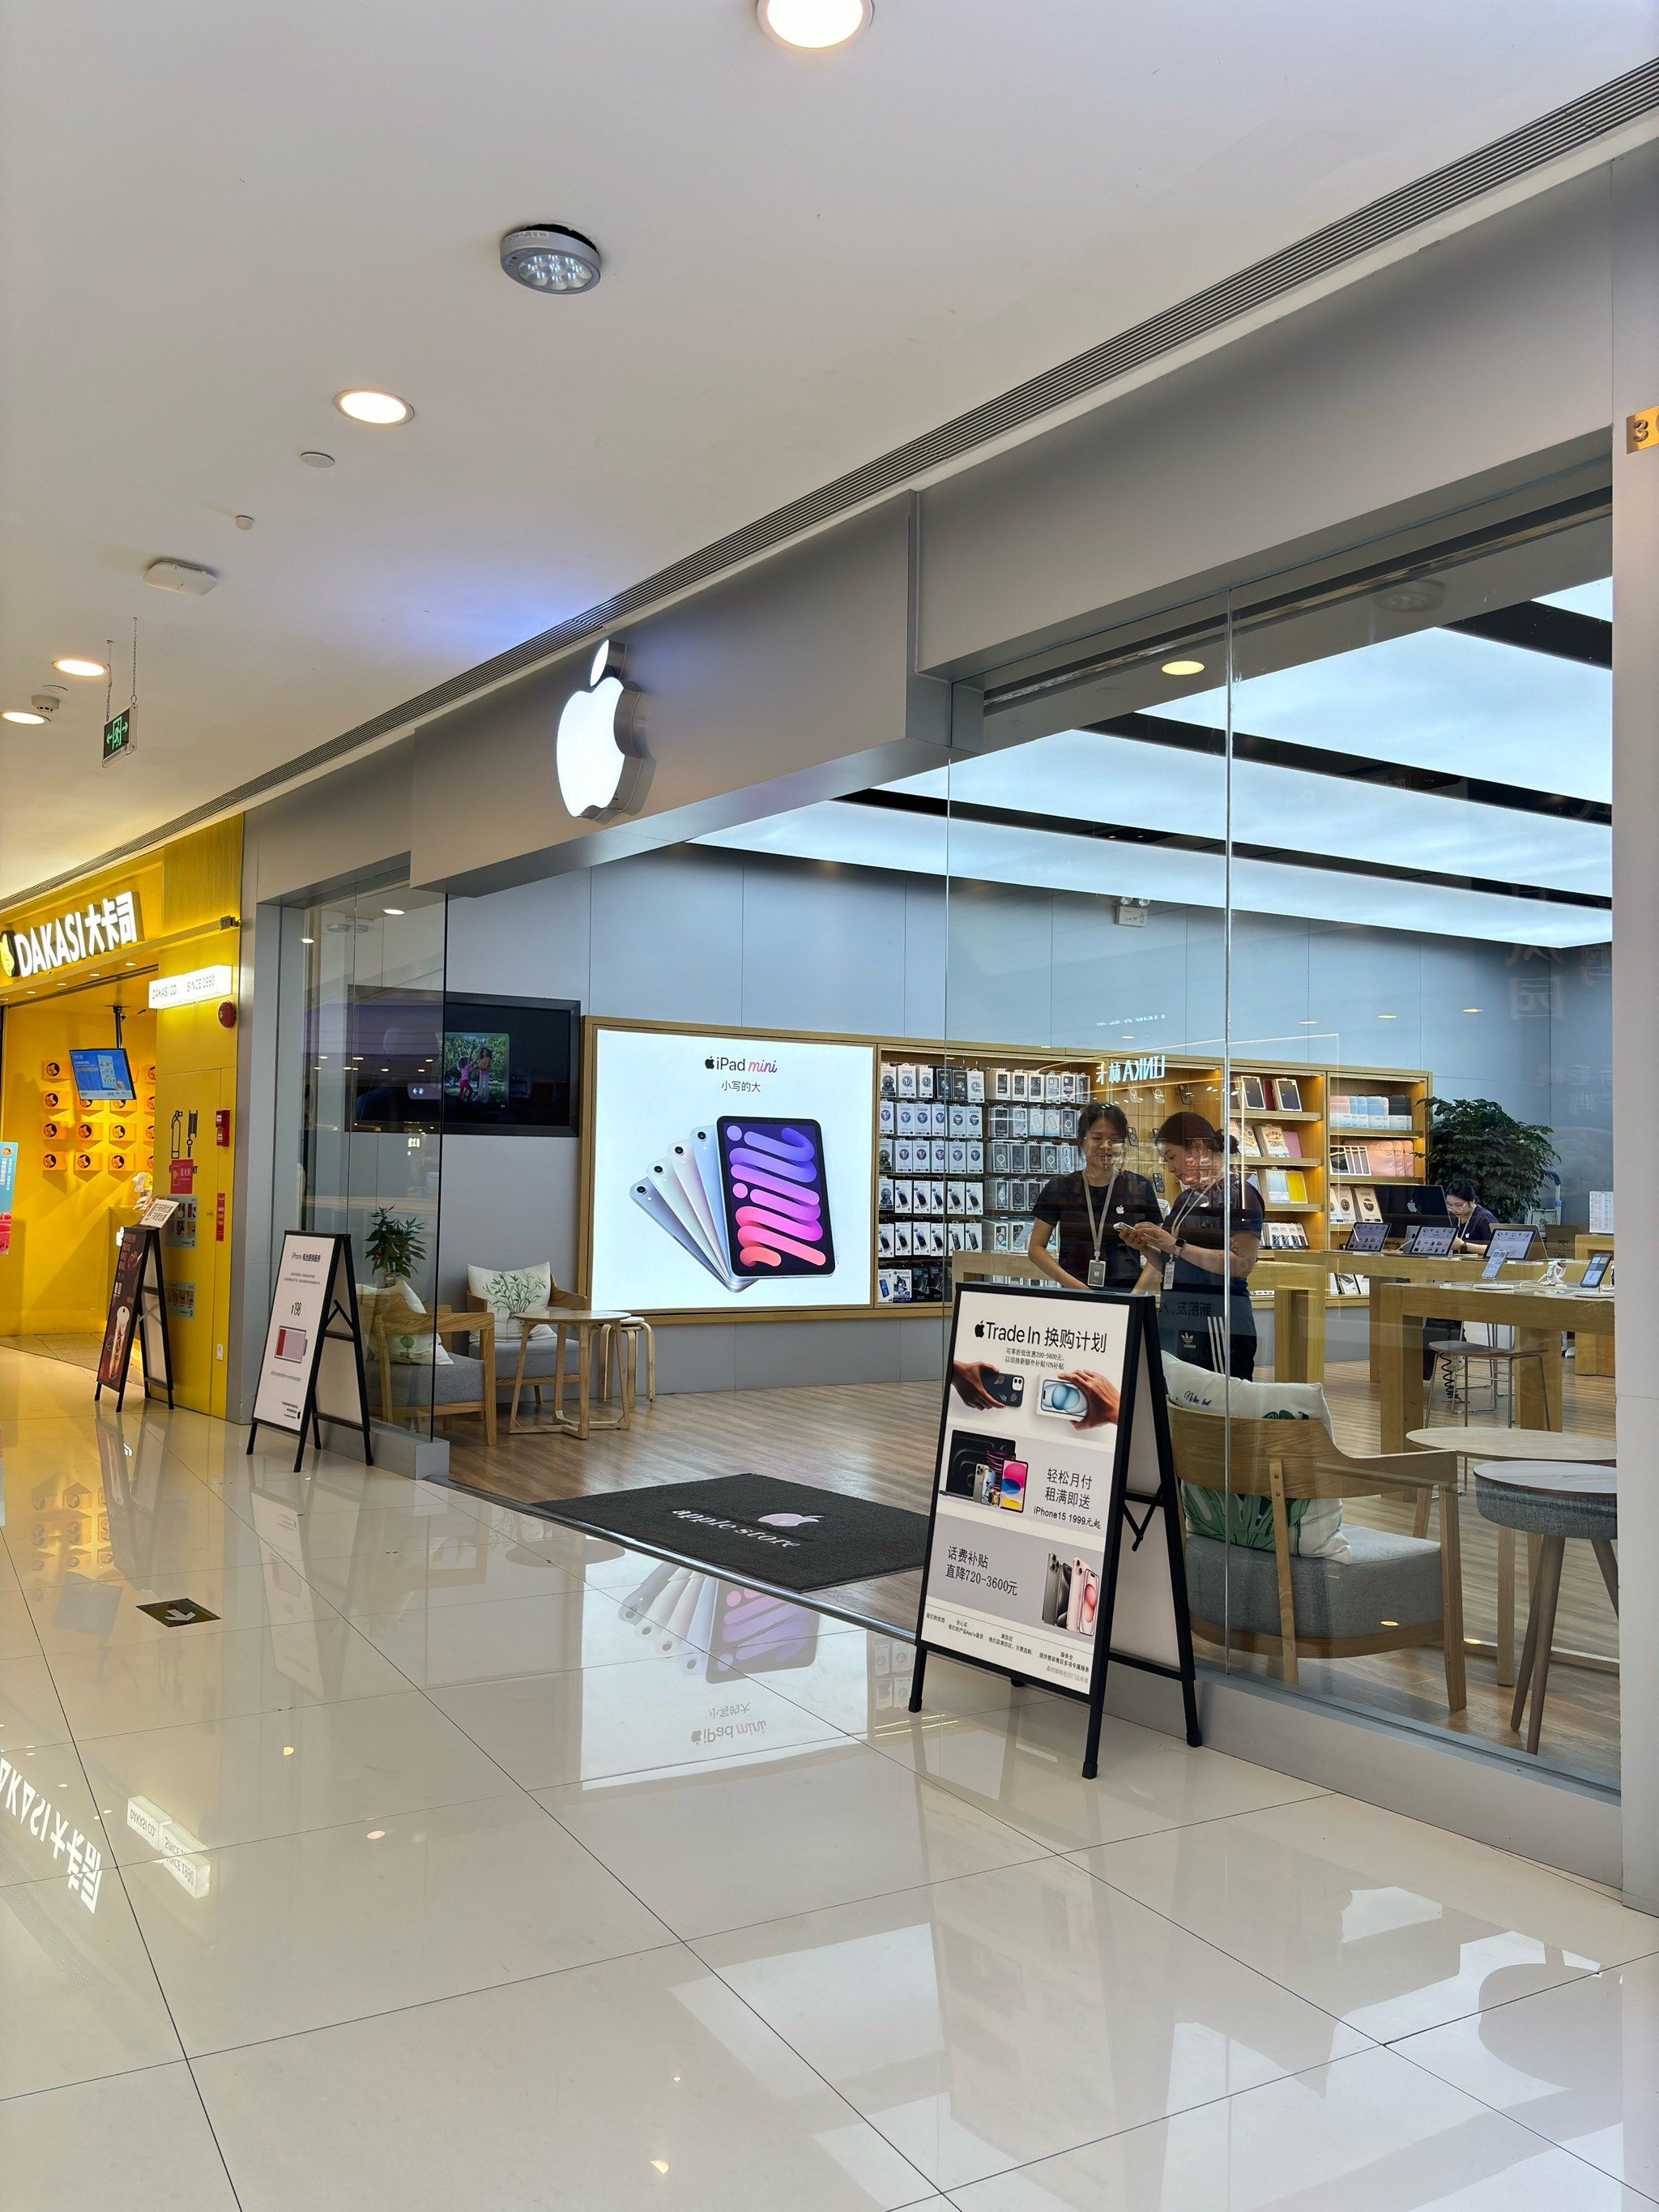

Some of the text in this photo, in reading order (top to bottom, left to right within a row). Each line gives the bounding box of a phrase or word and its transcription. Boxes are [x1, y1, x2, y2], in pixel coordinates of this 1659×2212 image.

[14, 890, 138, 977] DAKASI 大卡司
[716, 1057, 778, 1074] iPad mini
[721, 1080, 761, 1093] 小写的大
[986, 1322, 1107, 1354] Trade In 换购计划
[1047, 1467, 1093, 1490] 轻松月付
[1044, 1486, 1090, 1510] 租满即送
[672, 1510, 801, 1548] apple store
[1034, 1505, 1101, 1530] iPhone15 1999元起
[948, 1545, 989, 1569] 话费补贴
[945, 1563, 1018, 1596] 直降720-3600元
